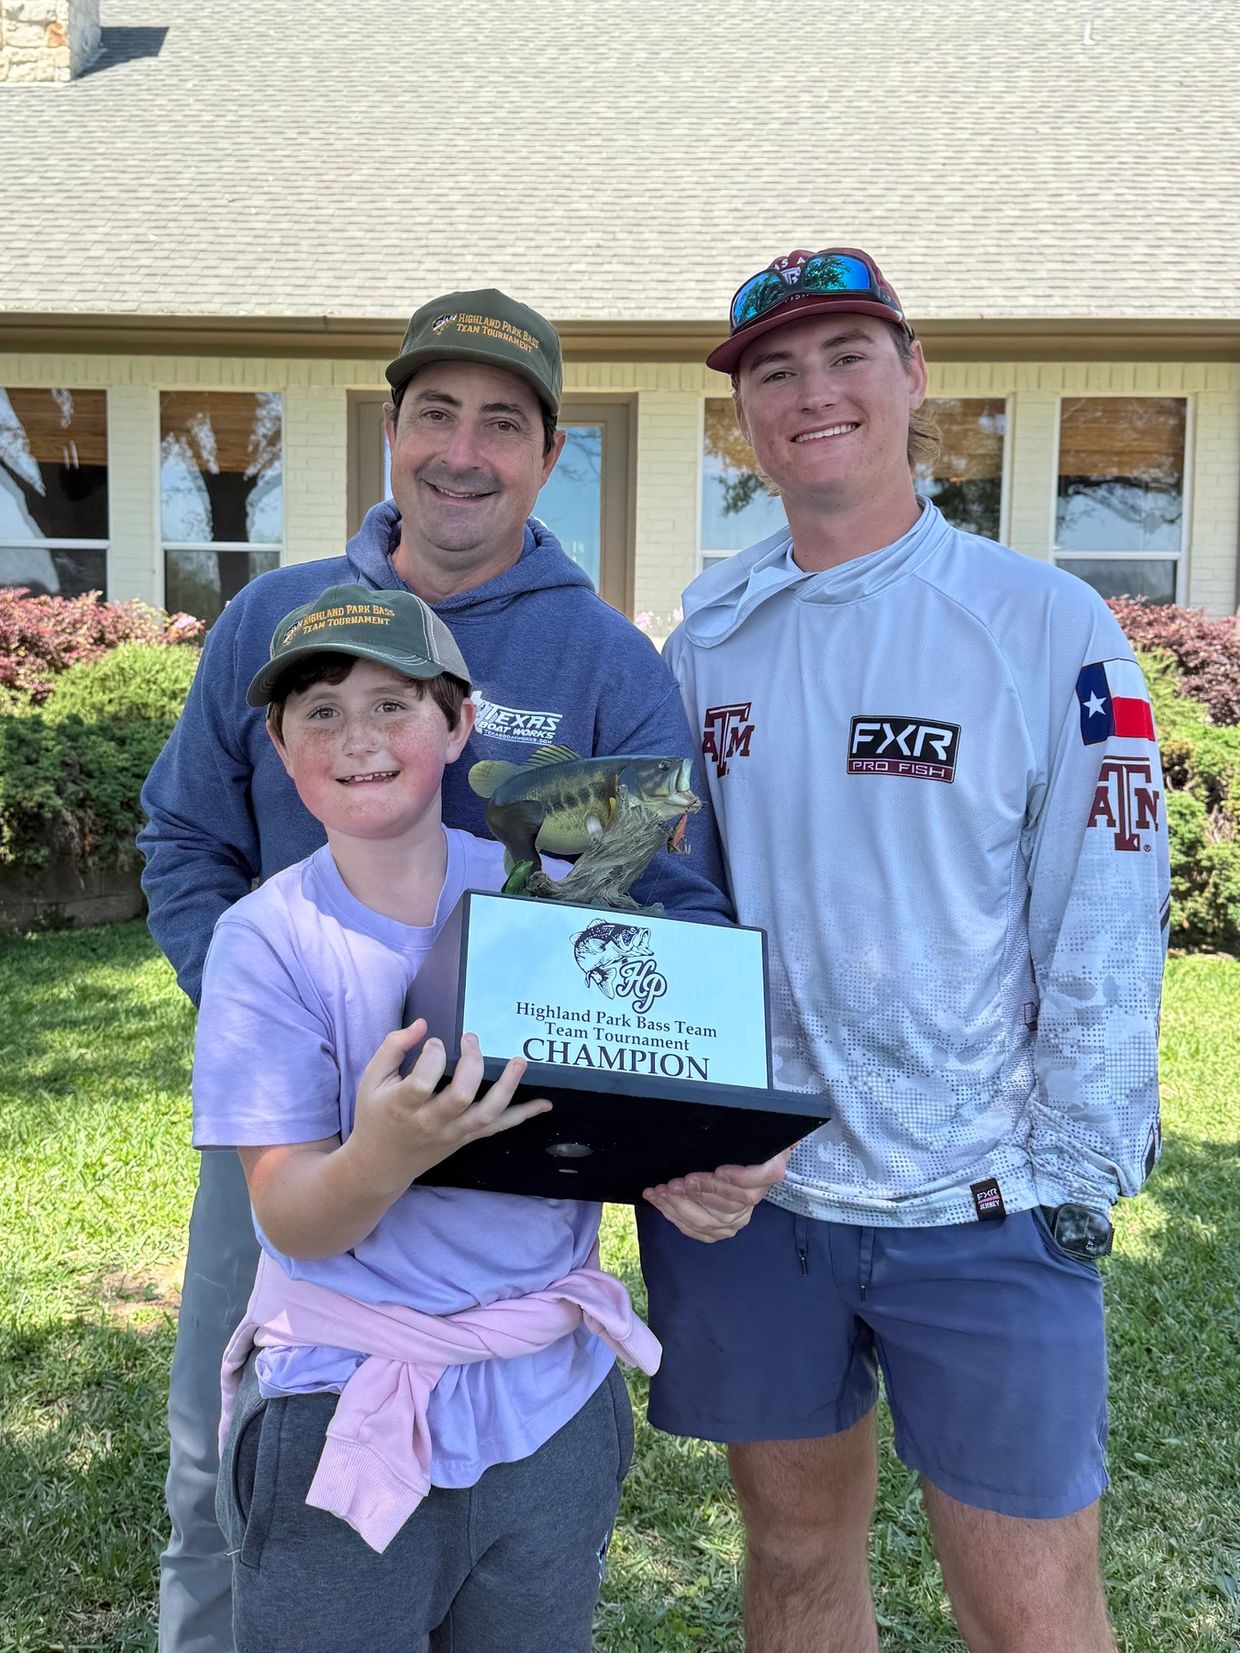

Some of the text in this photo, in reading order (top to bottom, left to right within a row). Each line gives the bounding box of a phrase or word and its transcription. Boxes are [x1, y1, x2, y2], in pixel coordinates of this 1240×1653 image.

[457, 323, 533, 352] TEAM TOURNAMENT
[459, 313, 540, 348] HIGHLAND PARK BASS
[303, 604, 396, 626] HIGHLAND PARK BASS
[303, 616, 391, 635] TEAM TOURNAMENT
[479, 721, 555, 740] BOAT WORKS
[484, 703, 563, 731] TEXAS
[852, 723, 953, 760] FXR
[852, 761, 945, 778] PRO FISH
[616, 959, 667, 1014] HP
[516, 1002, 717, 1038] Highland Park Bass Team
[545, 1021, 690, 1051] Team Tournament
[523, 1038, 710, 1081] CHAMPION
[977, 1188, 998, 1200] FXR
